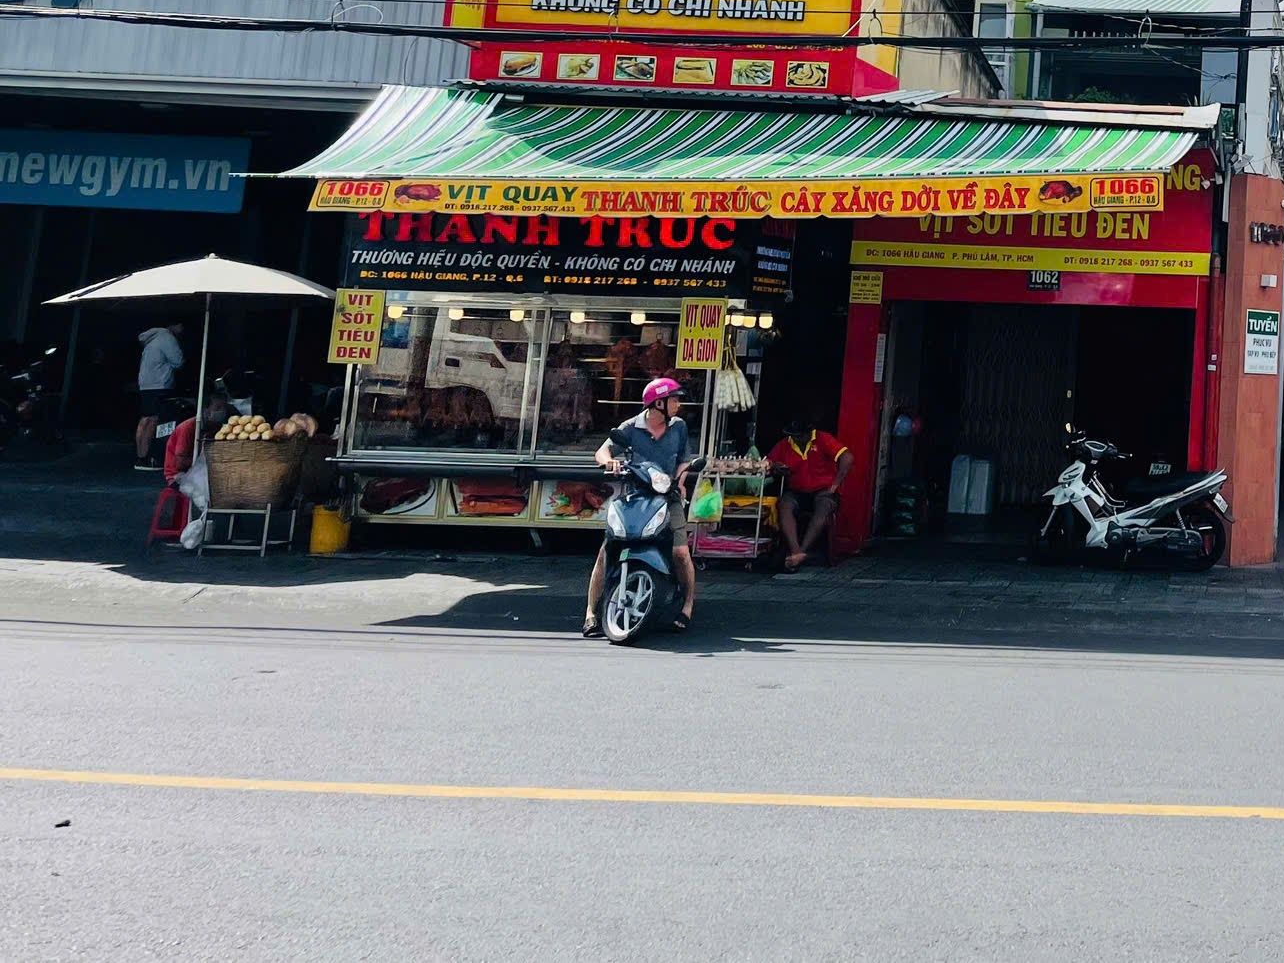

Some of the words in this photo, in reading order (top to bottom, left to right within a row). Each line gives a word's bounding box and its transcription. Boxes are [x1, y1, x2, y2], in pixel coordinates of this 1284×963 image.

[0, 150, 232, 197] newgym.vn
[327, 181, 384, 197] 1066
[1095, 179, 1154, 196] 1066
[447, 184, 493, 204] VỊT
[502, 185, 579, 203] QUAY
[581, 190, 685, 214] THANH
[691, 185, 772, 214] TRÚC
[780, 186, 827, 214] CÂY
[831, 185, 894, 213] XĂNG
[901, 183, 944, 211] DỜI
[948, 180, 980, 210] VỀ
[985, 182, 1032, 210] ĐÂY
[357, 212, 561, 247] THANH
[351, 248, 415, 267] THƯƠNG
[460, 250, 494, 269] ĐỘC
[497, 249, 552, 269] QUYỀN
[565, 254, 620, 271] KHÔNG
[624, 254, 646, 272] CÓ
[650, 258, 677, 272] CHI
[680, 256, 736, 274] NHÁNH
[882, 250, 902, 258] 1066
[922, 251, 945, 260] GIANG
[1016, 254, 1034, 263] HCM
[1079, 257, 1099, 265] 0918
[1101, 258, 1116, 266] 217
[1118, 258, 1133, 267] 268
[1140, 259, 1159, 267] 0937
[1162, 260, 1176, 268] 567
[1178, 260, 1193, 268] 433
[381, 271, 408, 279] 1066
[593, 276, 614, 285] 217
[683, 279, 703, 288] 567
[705, 280, 727, 288] 433
[1030, 270, 1059, 285] 1062
[347, 294, 374, 312] VỊT
[684, 304, 699, 334] VỊT
[700, 304, 722, 332] QUAY
[336, 347, 371, 360] ĐEN
